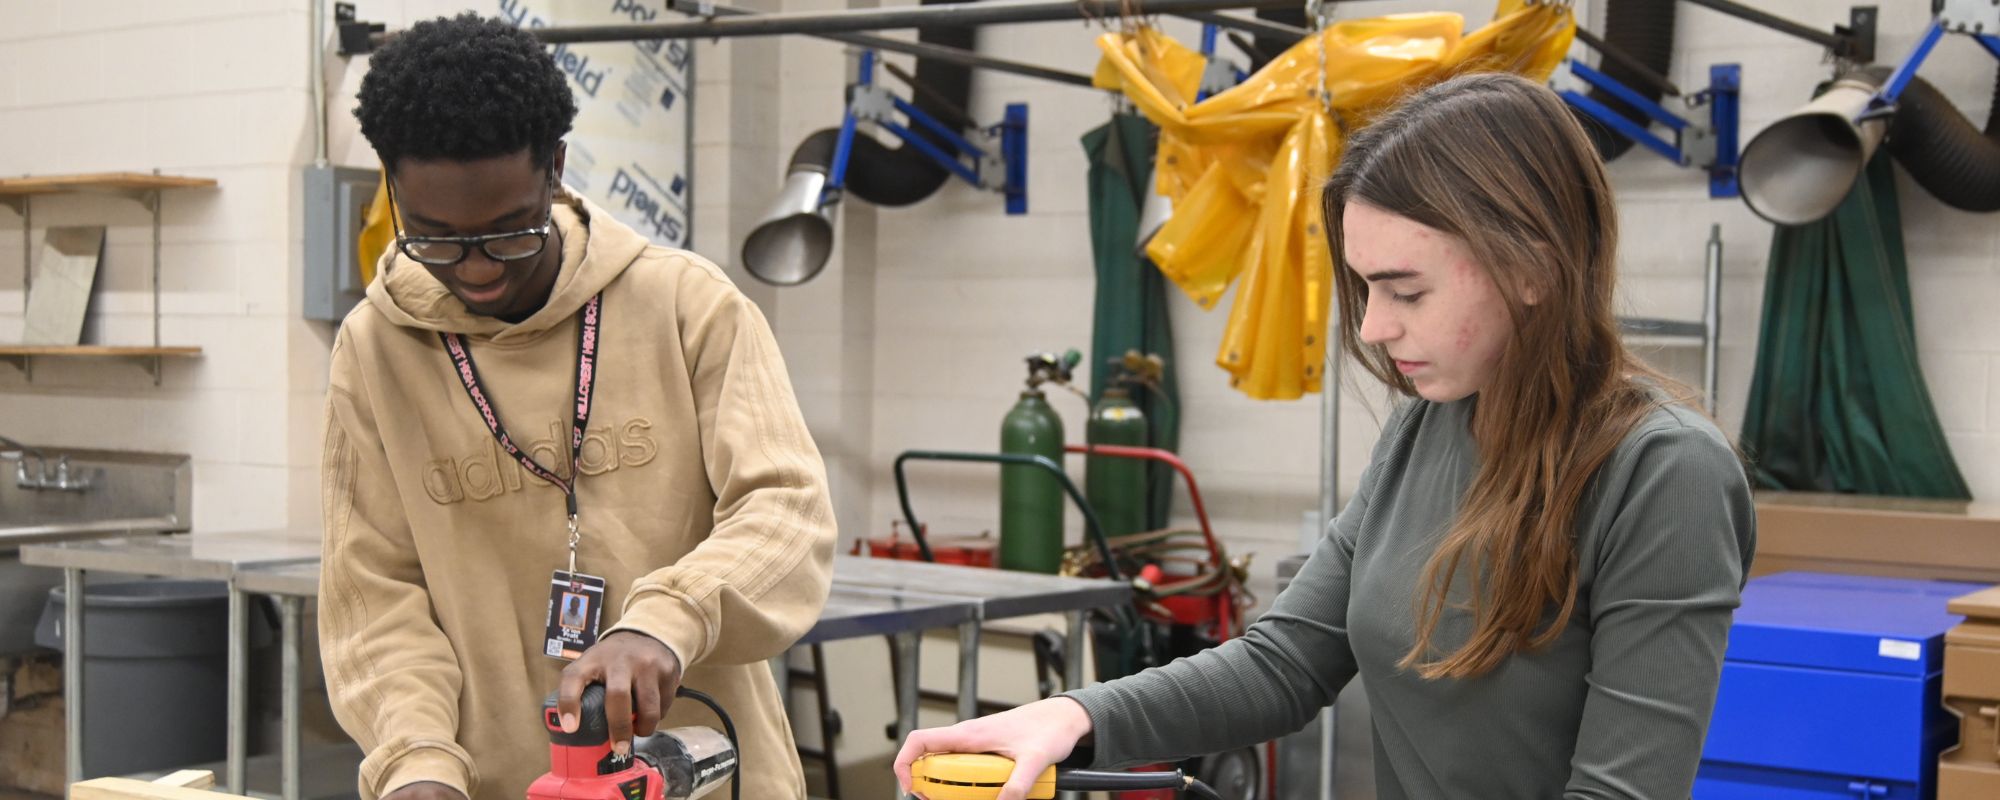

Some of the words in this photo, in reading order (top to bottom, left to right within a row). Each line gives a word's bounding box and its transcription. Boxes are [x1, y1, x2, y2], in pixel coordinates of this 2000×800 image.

[582, 325, 597, 354] HIGH
[458, 359, 476, 388] HIGH
[470, 384, 498, 434] SCHOOL
[577, 355, 593, 421] HILLCREST
[422, 417, 658, 505] adidas
